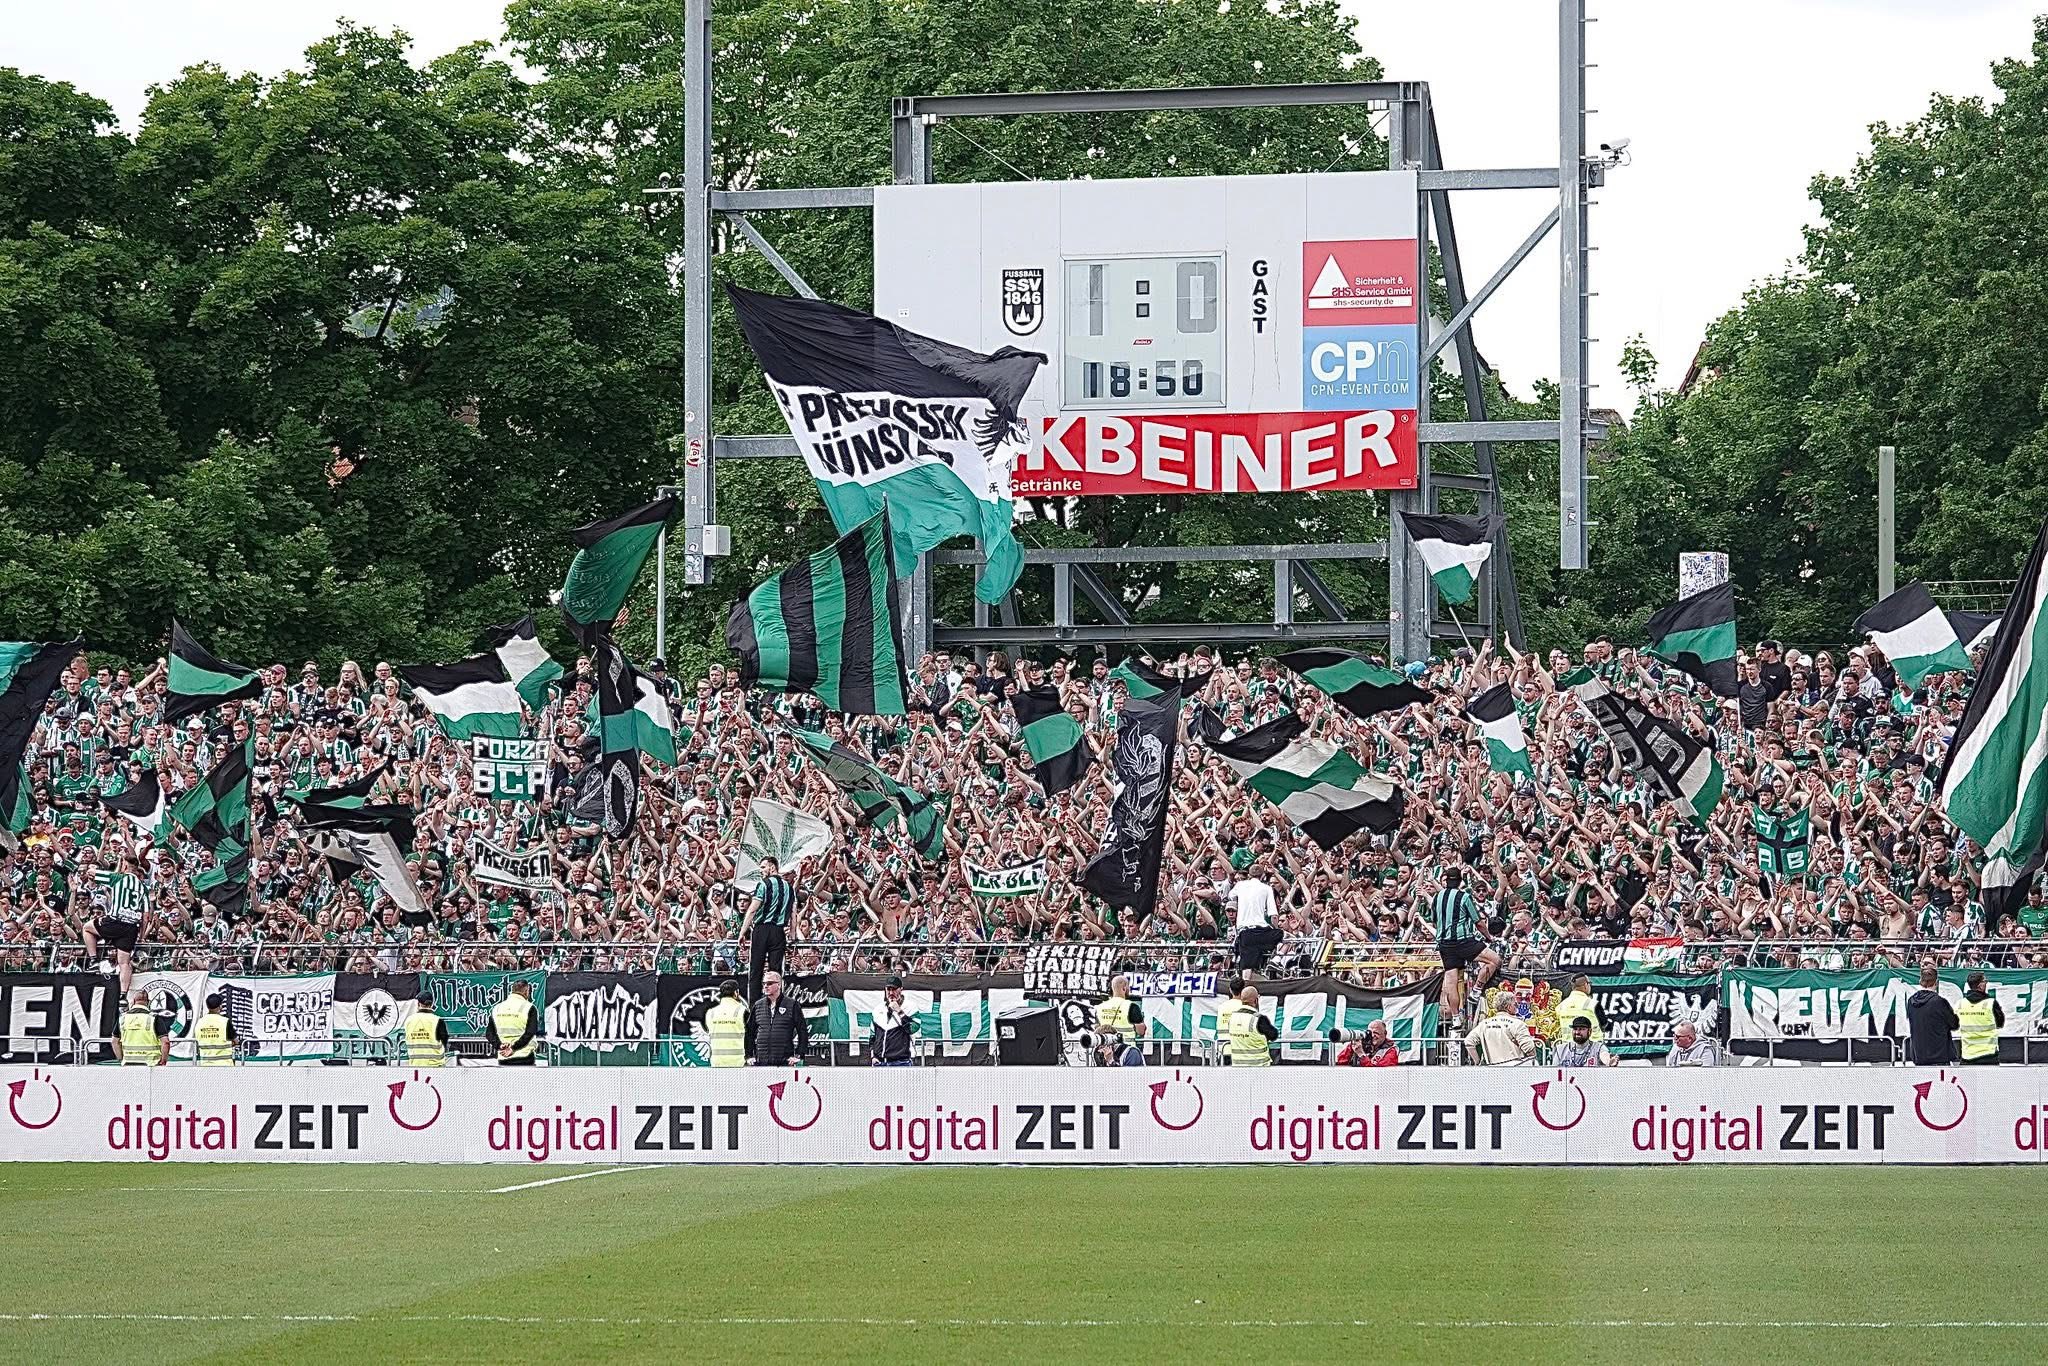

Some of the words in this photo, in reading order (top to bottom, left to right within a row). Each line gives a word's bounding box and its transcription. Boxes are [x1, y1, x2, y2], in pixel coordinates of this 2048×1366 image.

[1004, 279, 1041, 292] SSV
[1355, 277, 1395, 286] Sicherheit
[1355, 287, 1385, 297] Service
[1387, 286, 1413, 296] GmbH
[1004, 292, 1041, 305] 1846
[1252, 260, 1268, 333] GAST
[1333, 299, 1394, 307] shs-security.de
[1311, 383, 1409, 396] CPN-EVENT.COM
[1011, 409, 1401, 493] KBEINER
[1011, 478, 1082, 493] Getränke
[473, 736, 551, 760] FORZA
[473, 762, 547, 795] SCP
[1027, 944, 1118, 961] SEKTION
[1023, 957, 1112, 975] STADION
[1023, 972, 1111, 993] VERBOT
[257, 990, 333, 1014] COERDE
[430, 975, 540, 1015] Münstr
[675, 990, 721, 1021] FAN-K
[1636, 986, 1671, 1016] FÜR
[0, 986, 105, 1053] EN
[264, 1012, 327, 1034] BANDE
[109, 1104, 236, 1159] digital
[254, 1104, 368, 1149] ZEIT
[488, 1105, 616, 1161] digital
[634, 1105, 748, 1149] ZEIT
[870, 1105, 997, 1160] digital
[1015, 1105, 1129, 1149] ZEIT
[1251, 1105, 1379, 1160] digital
[1397, 1105, 1511, 1149] ZEIT
[1632, 1105, 1761, 1160] digital
[1779, 1105, 1894, 1149] ZEIT
